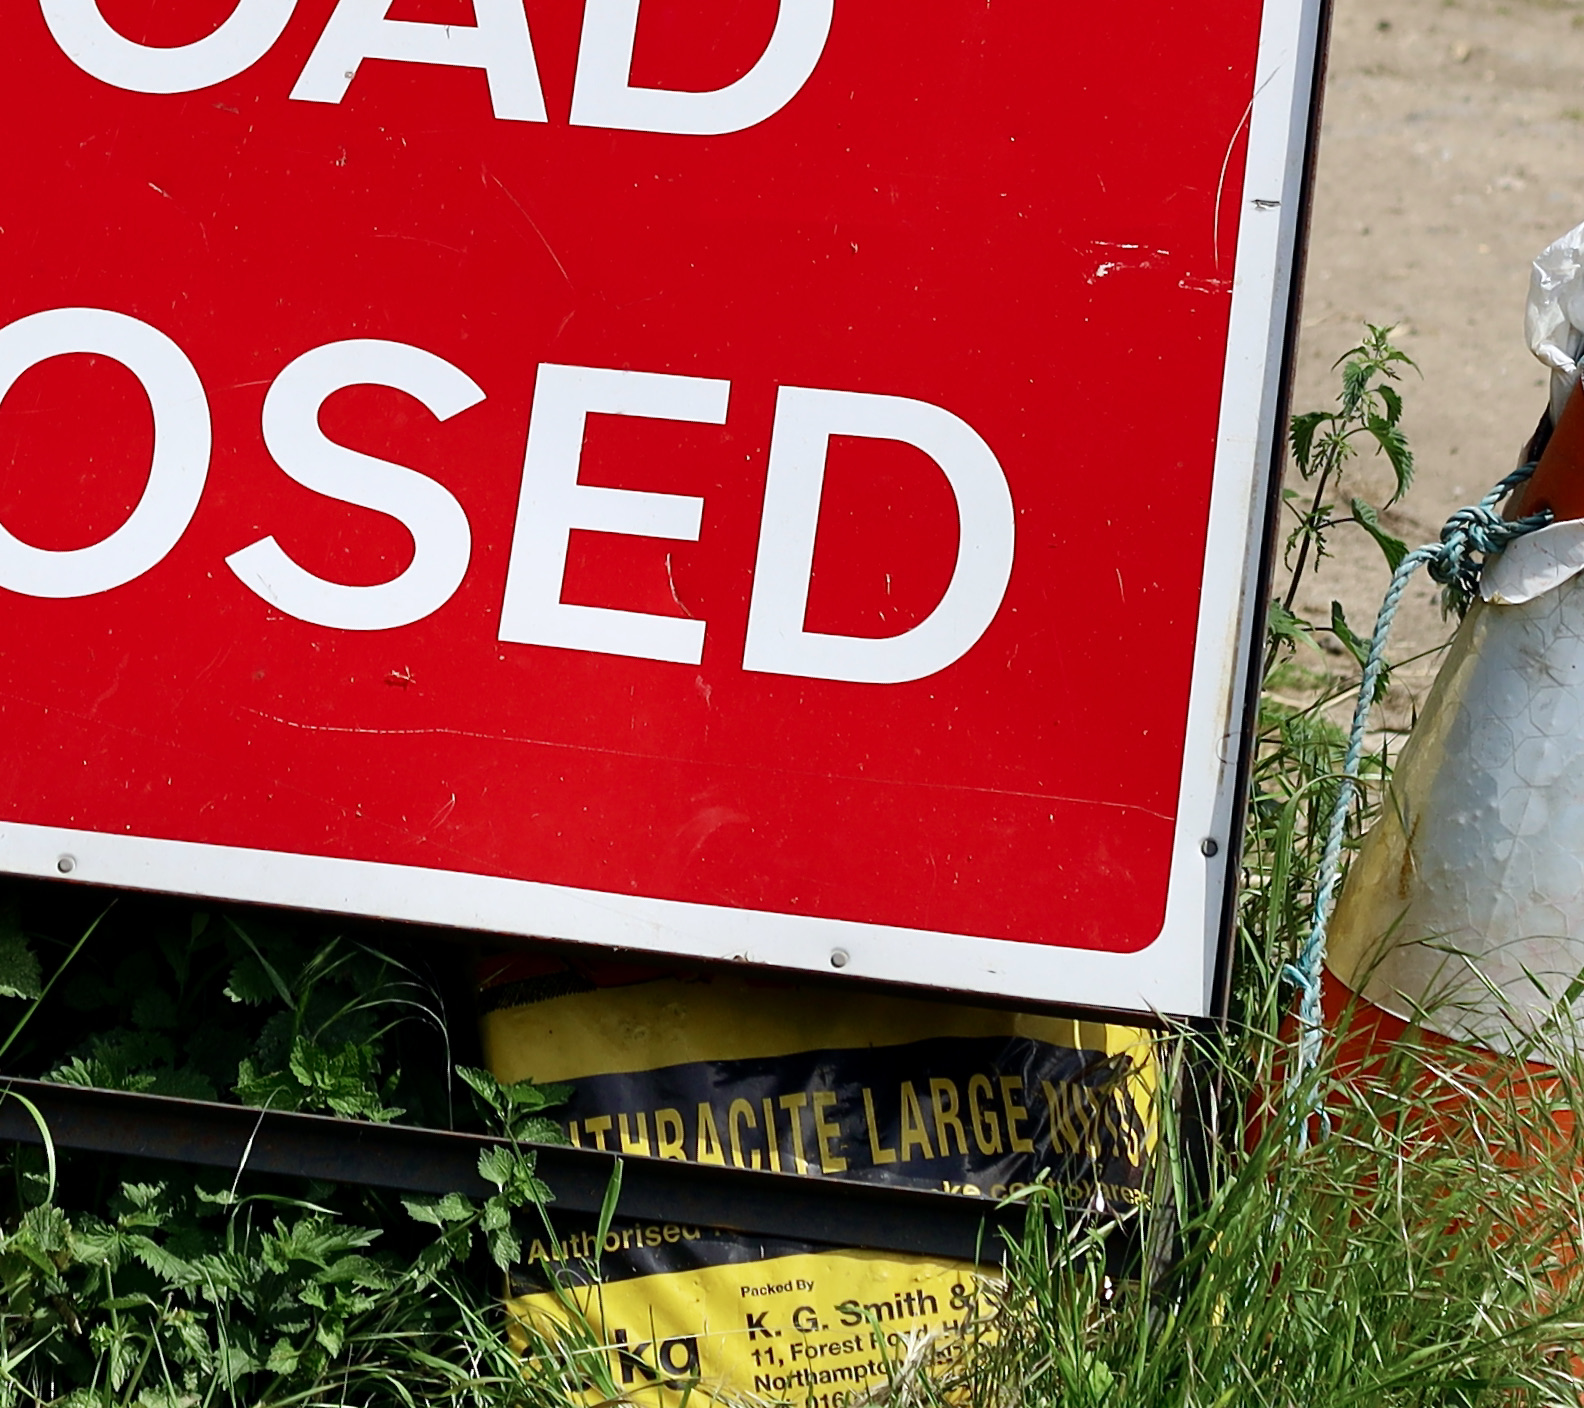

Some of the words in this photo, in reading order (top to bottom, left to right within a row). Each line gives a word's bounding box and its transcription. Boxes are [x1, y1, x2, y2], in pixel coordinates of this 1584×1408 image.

[569, 1091, 848, 1175] THRACITE
[862, 1073, 1035, 1165] LARGE
[741, 1282, 793, 1298] Packed
[796, 1279, 815, 1292] By
[746, 1311, 781, 1341] K.
[792, 1306, 829, 1333] G.
[840, 1289, 938, 1328] Smith
[950, 1283, 971, 1311] &
[614, 1329, 701, 1392] kg
[752, 1348, 784, 1368] 11,
[790, 1334, 864, 1362] Forest
